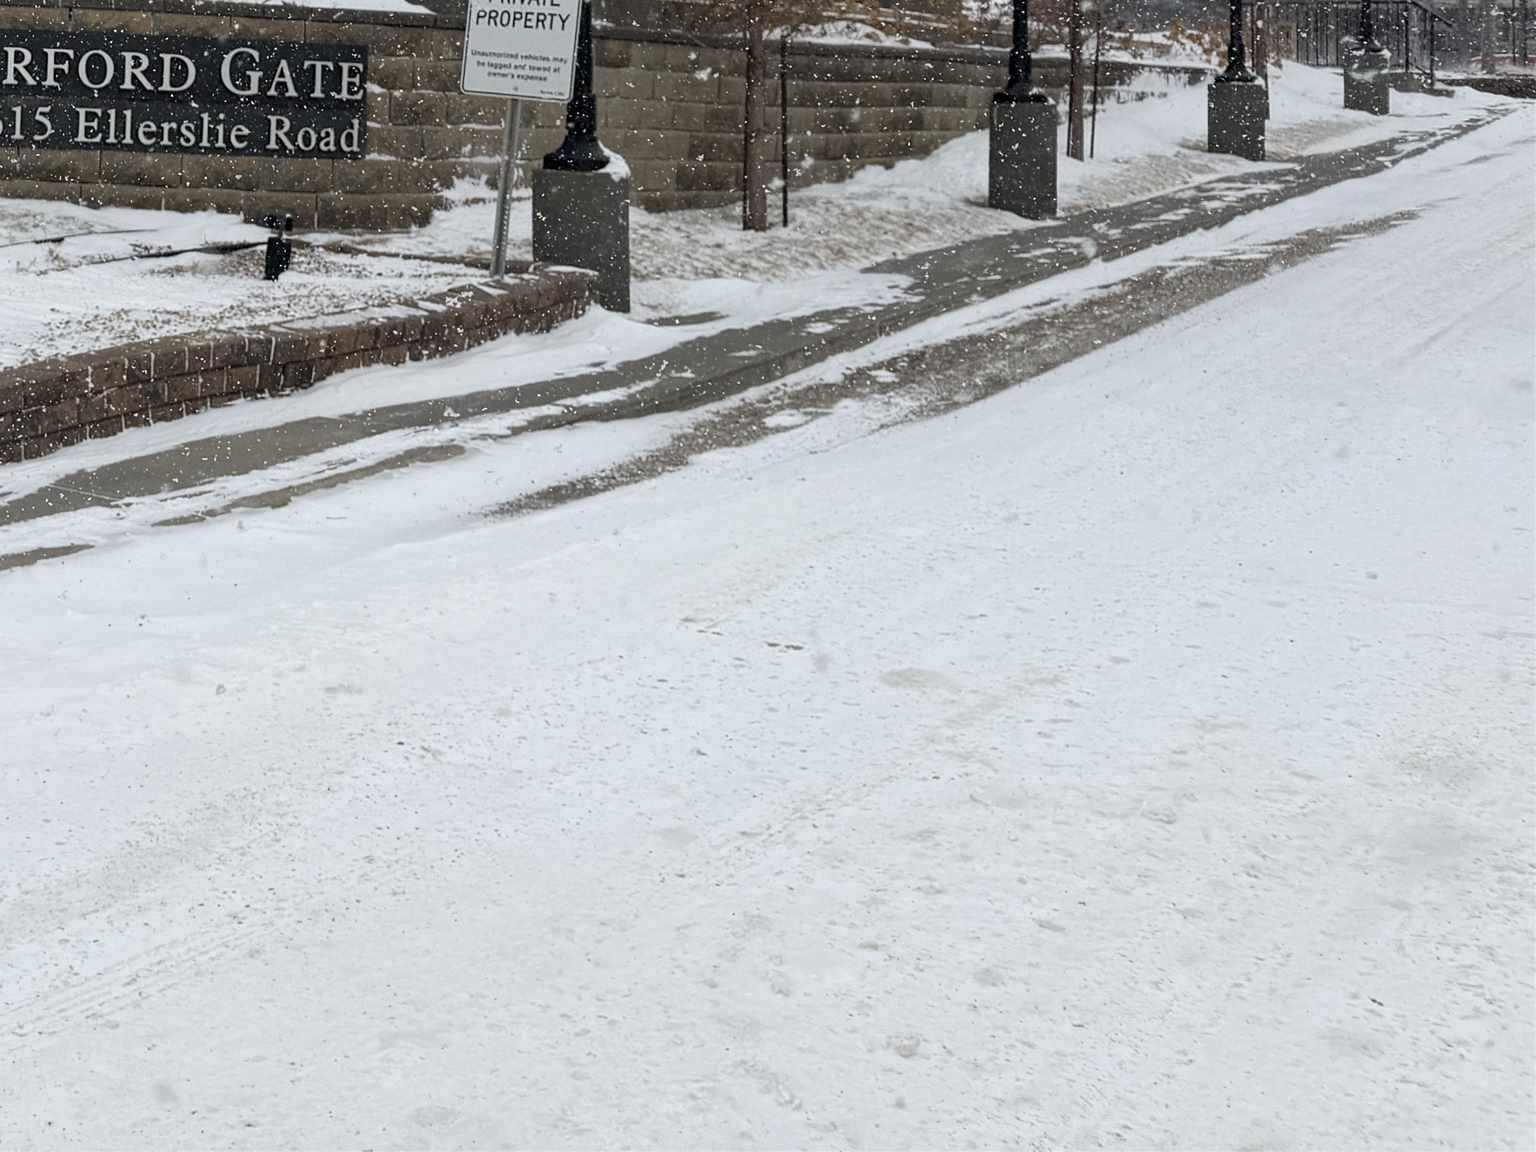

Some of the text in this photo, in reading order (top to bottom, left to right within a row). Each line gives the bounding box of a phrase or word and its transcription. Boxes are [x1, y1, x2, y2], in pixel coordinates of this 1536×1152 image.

[476, 10, 570, 31] PROPERTY
[221, 48, 364, 99] GATE
[74, 107, 251, 148] Ellerslie
[266, 114, 361, 152] Road
